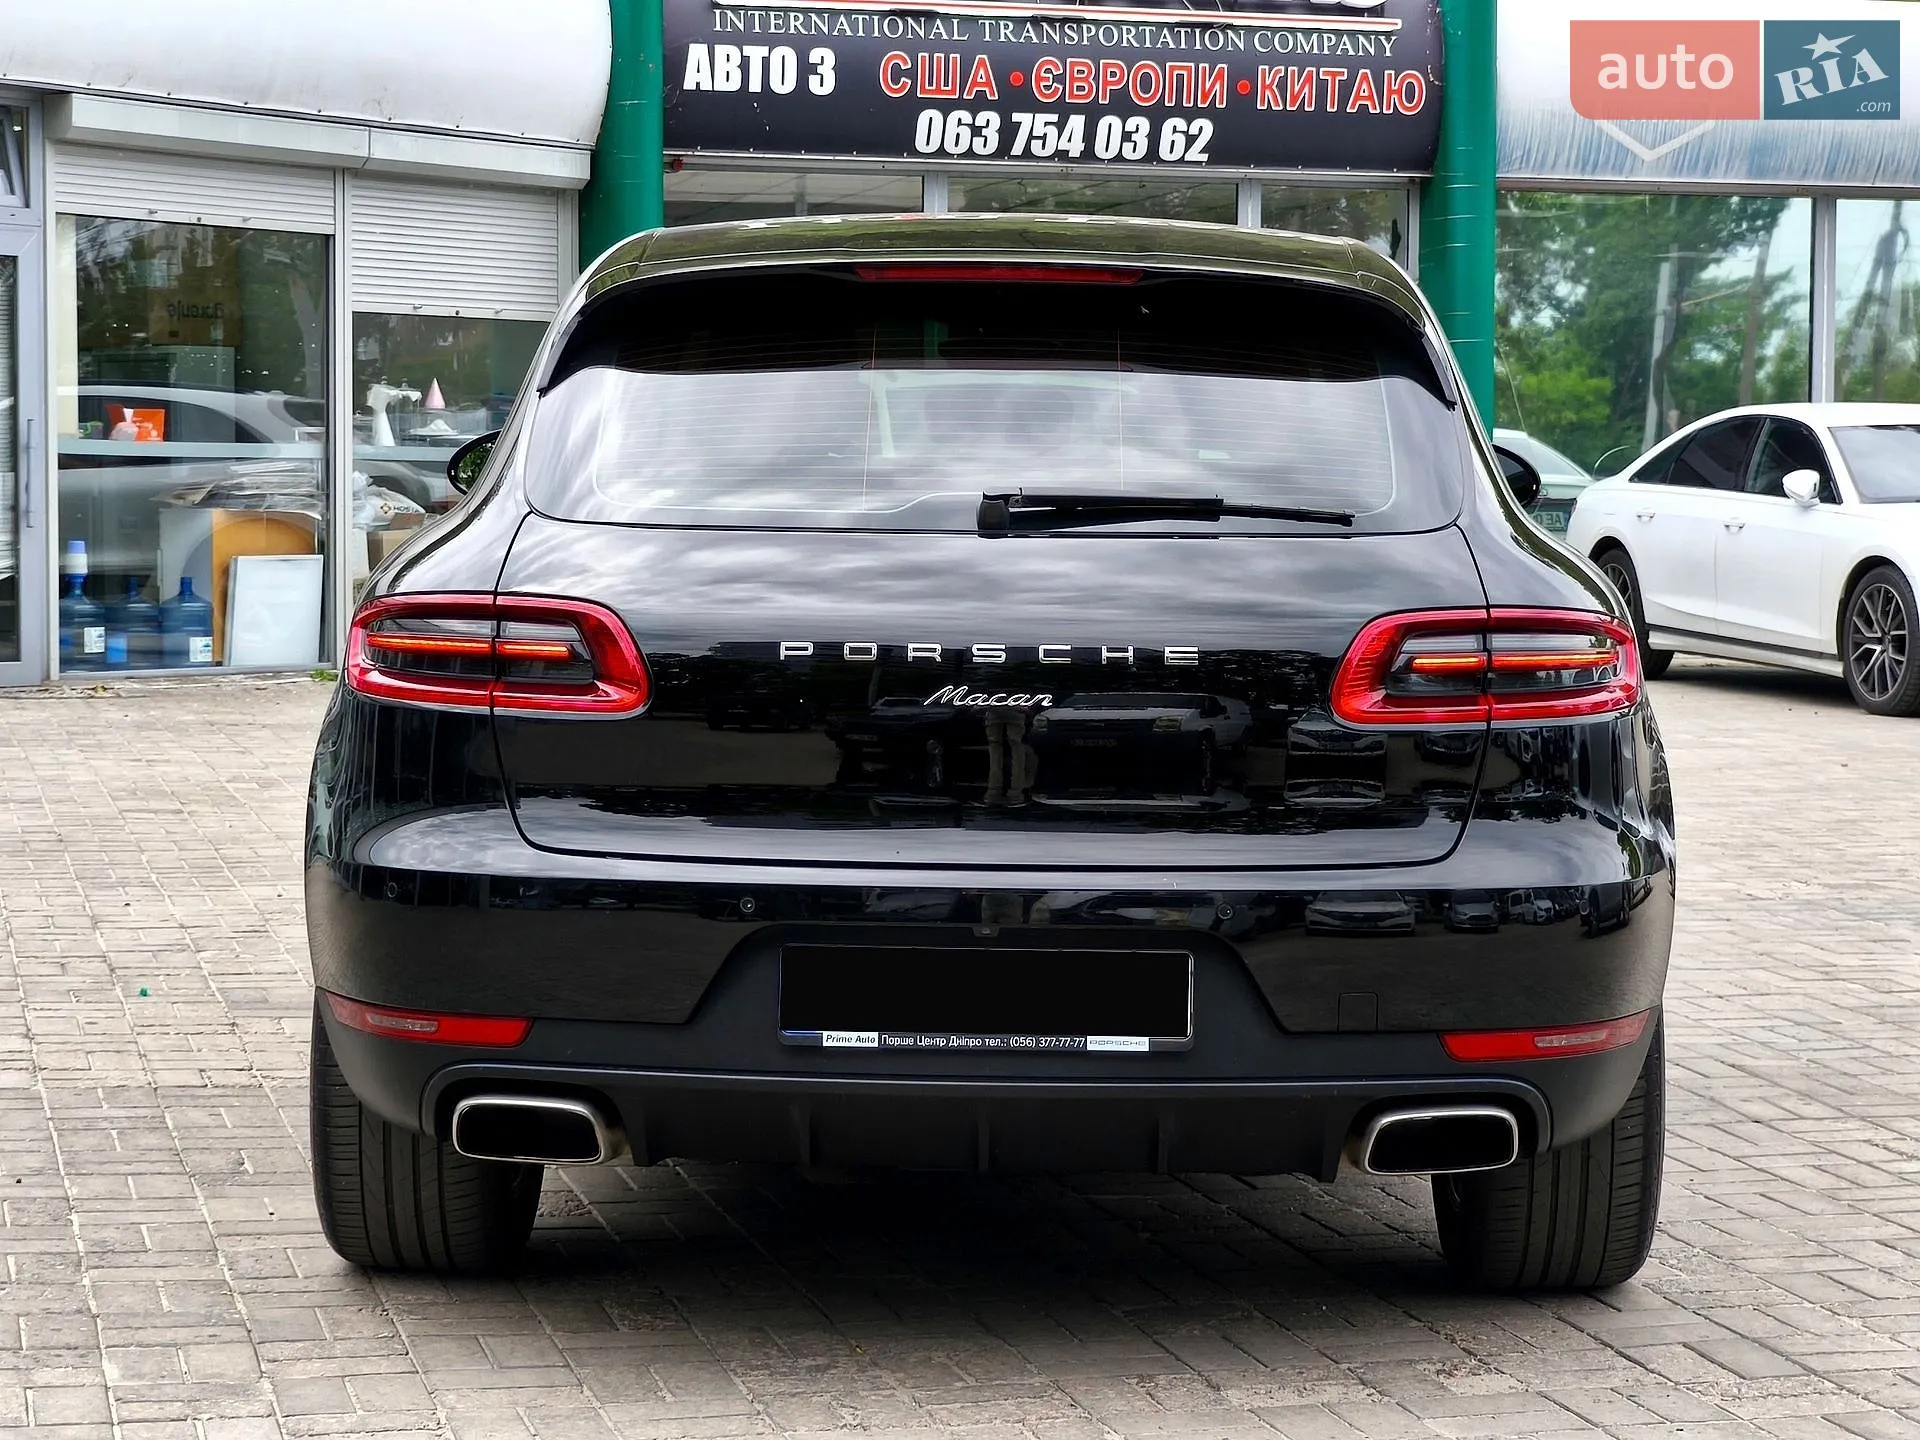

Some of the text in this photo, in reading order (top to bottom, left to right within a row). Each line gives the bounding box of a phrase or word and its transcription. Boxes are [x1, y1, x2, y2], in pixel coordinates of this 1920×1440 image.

[712, 8, 1398, 58] INTERNATIONAL TRANSPORTATION COMPANY
[682, 43, 798, 95] АВТО
[879, 50, 1000, 101] США
[1031, 56, 1228, 109] ЄВРОПИ
[1256, 65, 1426, 116] КИТАЮ
[913, 108, 1214, 163] 063 754 03 62
[779, 641, 1200, 666] PORSCHE
[923, 684, 1054, 707] Macan
[825, 1034, 853, 1044] Prime
[855, 1035, 876, 1045] Auto
[881, 1034, 914, 1046] Порше
[916, 1036, 947, 1047] Центр
[949, 1036, 982, 1048] Дніпро
[1009, 1037, 1036, 1048] (056)
[1038, 1037, 1086, 1049] 377-77-77
